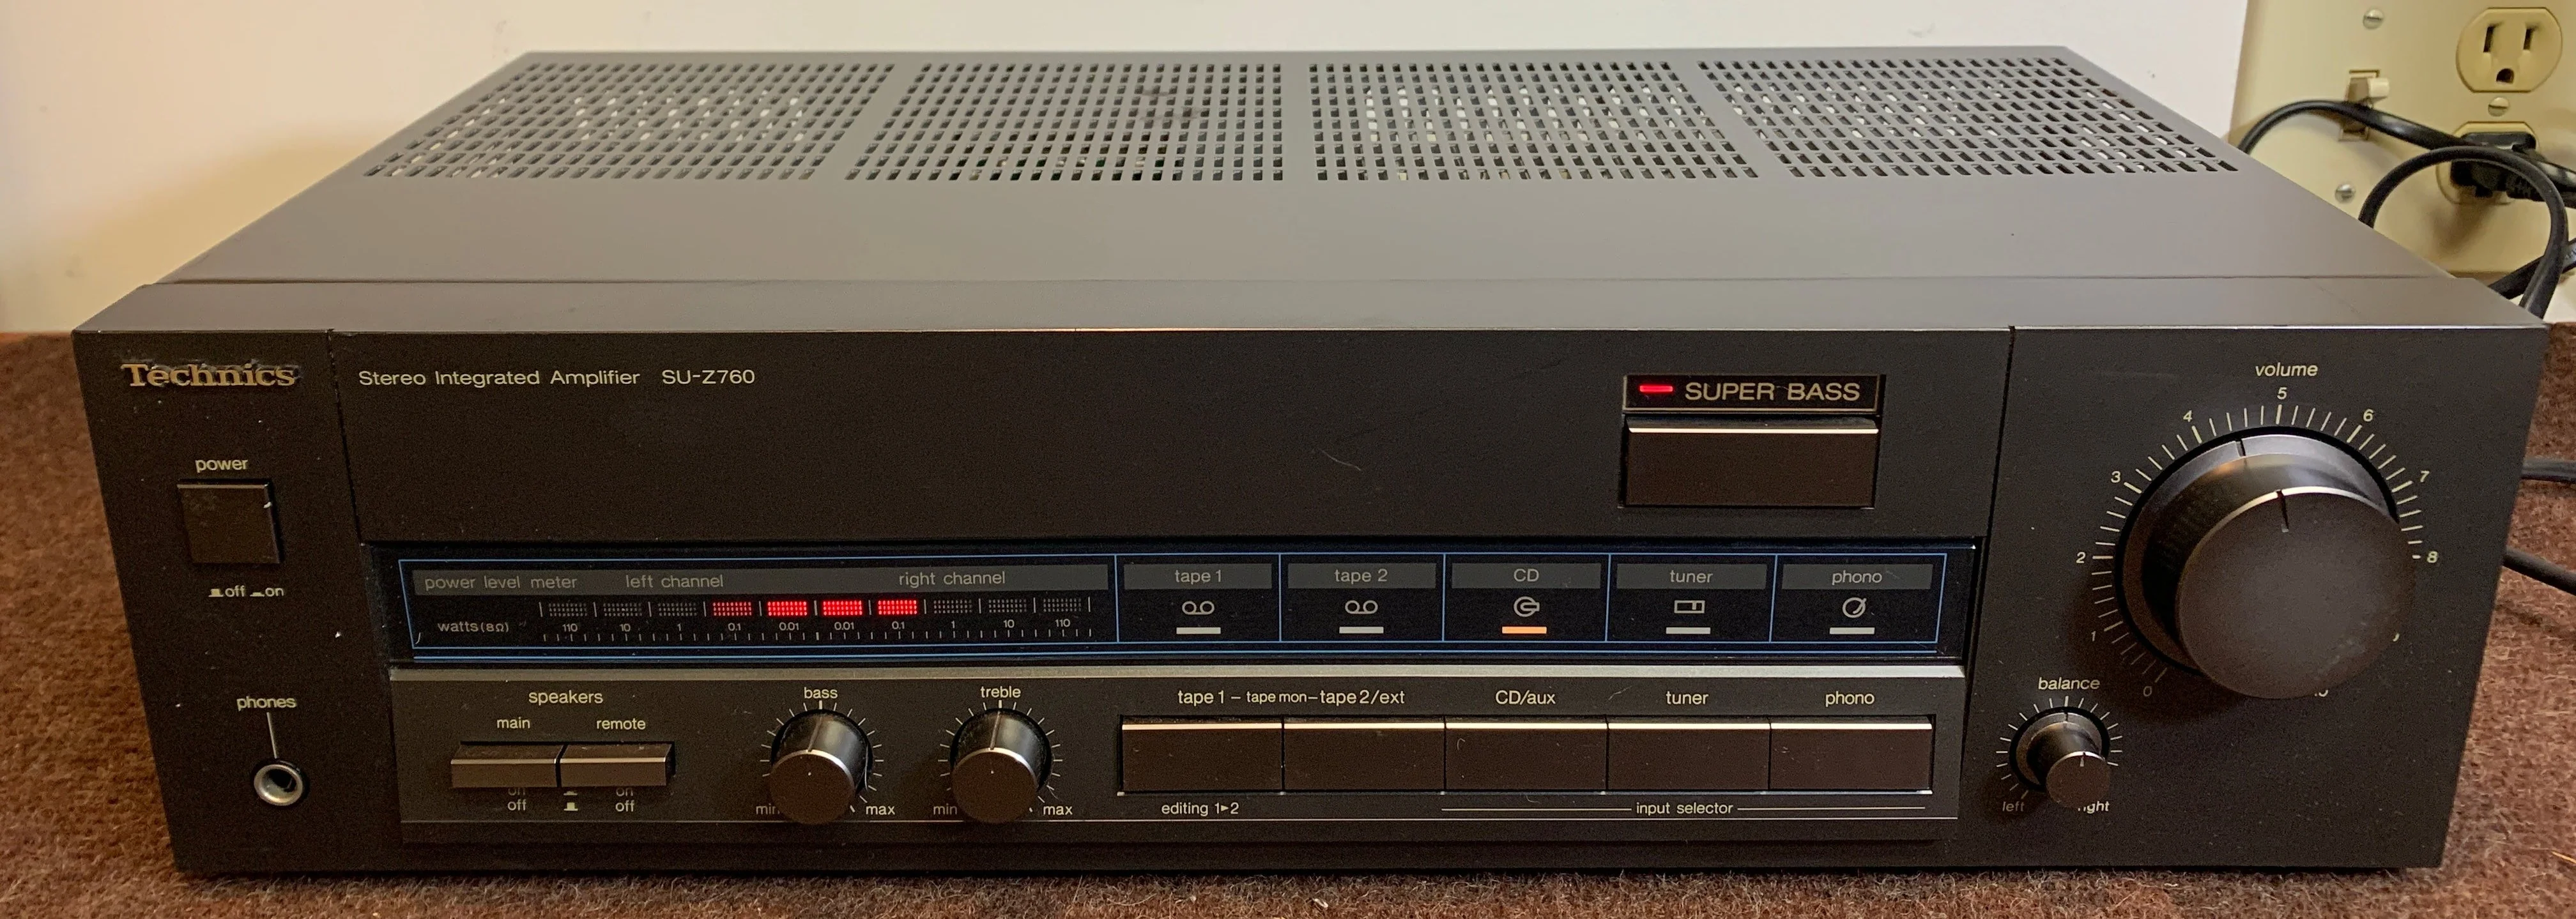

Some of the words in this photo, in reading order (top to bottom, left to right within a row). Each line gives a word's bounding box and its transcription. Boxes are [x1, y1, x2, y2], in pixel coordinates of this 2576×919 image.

[119, 360, 298, 388] Technics
[2255, 361, 2319, 377] volume
[358, 370, 426, 386] Stereo
[435, 370, 540, 388] Integrated
[549, 370, 641, 388] Amplifier
[662, 369, 755, 384] SU-Z760
[1685, 382, 1775, 401] SUPER
[1787, 383, 1860, 401] BASS
[2277, 386, 2287, 400] 5
[2182, 410, 2193, 422] 4
[2363, 409, 2374, 422] 6
[195, 459, 249, 473] power
[2110, 471, 2121, 483] 3
[2420, 470, 2430, 483] 7
[2076, 551, 2086, 564] 2
[2426, 551, 2438, 563] 8
[625, 574, 654, 588] left
[661, 574, 724, 588] channel
[899, 572, 935, 589] right
[943, 570, 1006, 585] channel
[1174, 570, 1211, 585] tape
[1215, 569, 1222, 582] 1
[1335, 569, 1372, 585] tape
[1377, 568, 1388, 582] 2
[1514, 568, 1540, 582] CD
[1670, 570, 1713, 583] tuner
[1832, 570, 1883, 586] phono
[424, 578, 476, 591] power
[484, 575, 521, 589] level
[530, 576, 578, 589] meter
[224, 585, 245, 598] off
[263, 587, 284, 597] on
[562, 623, 578, 632] 110
[619, 623, 631, 632] 10
[677, 623, 682, 632] 1
[727, 622, 741, 632] 0.1
[778, 621, 799, 631] 0.01
[834, 621, 855, 631] 0.01
[891, 620, 905, 630] 0.1
[951, 620, 955, 629] 1
[1003, 619, 1015, 628] 10
[1055, 618, 1071, 628] 110
[2091, 630, 2096, 642] 1
[2038, 676, 2100, 690] balance
[804, 687, 838, 699] bass
[980, 685, 1022, 698] treble
[1495, 690, 1556, 705] CD/aux
[1666, 690, 1709, 705] tuner
[2143, 685, 2152, 697] 0
[236, 695, 297, 711] phones
[528, 690, 604, 706] speakers
[1177, 690, 1214, 707] tape
[1218, 690, 1224, 704] 1
[1246, 691, 1276, 704] tape
[1825, 690, 1875, 708] phono
[496, 717, 530, 729] main
[596, 718, 646, 730] remote
[615, 787, 634, 798] on
[507, 799, 526, 811] off
[615, 800, 634, 812] off
[866, 805, 895, 816] max
[933, 803, 958, 816] min
[1043, 805, 1073, 816] max
[1161, 801, 1209, 817] editing
[1636, 801, 1671, 816] input
[1676, 801, 1734, 814] selector
[2002, 801, 2025, 812] left
[2078, 801, 2110, 814] ght
